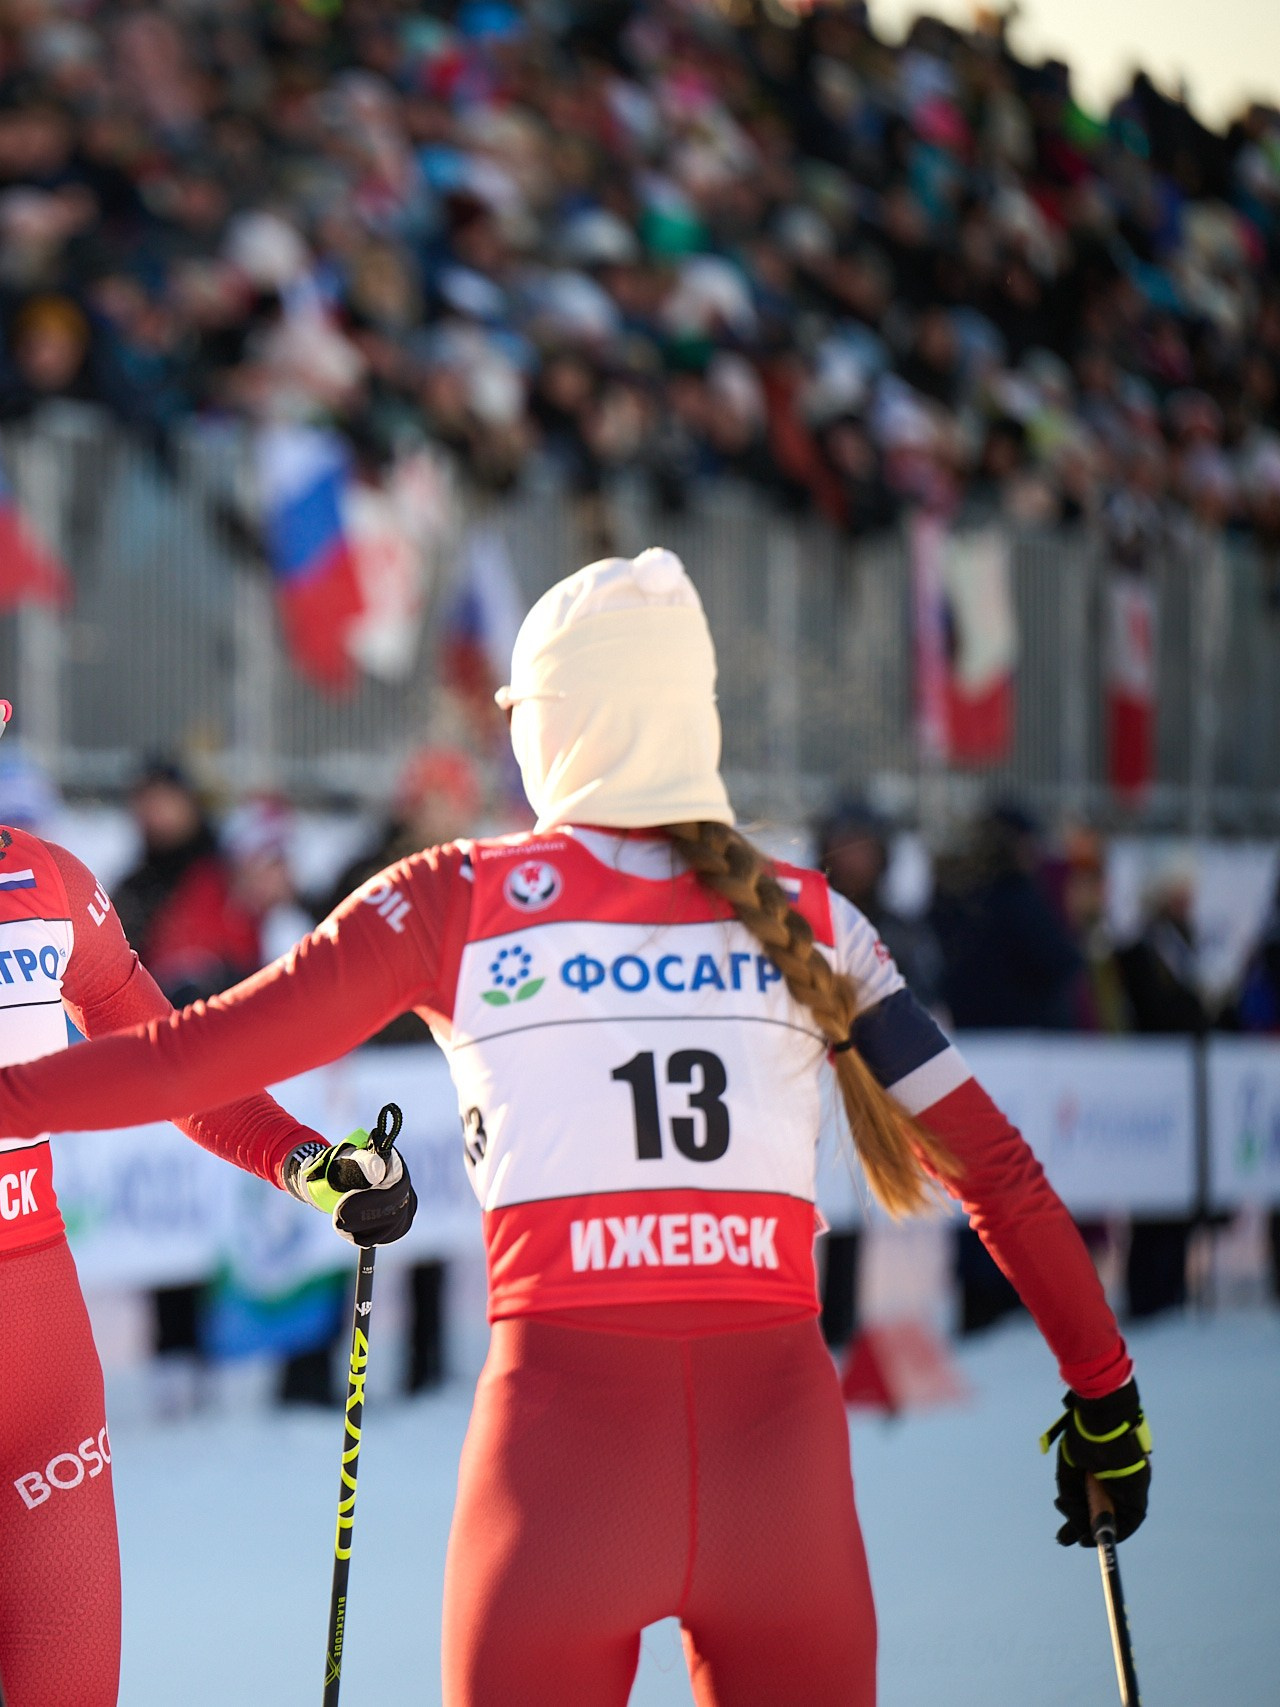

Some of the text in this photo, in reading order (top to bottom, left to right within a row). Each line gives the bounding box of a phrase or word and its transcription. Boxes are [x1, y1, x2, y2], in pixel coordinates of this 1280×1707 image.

[560, 952, 783, 993] ФОСАГР
[610, 1049, 730, 1162] 13
[570, 1211, 780, 1273] ИЖЕВСК
[13, 1424, 112, 1511] BOSC
[333, 1596, 346, 1658] BLACKCODE
